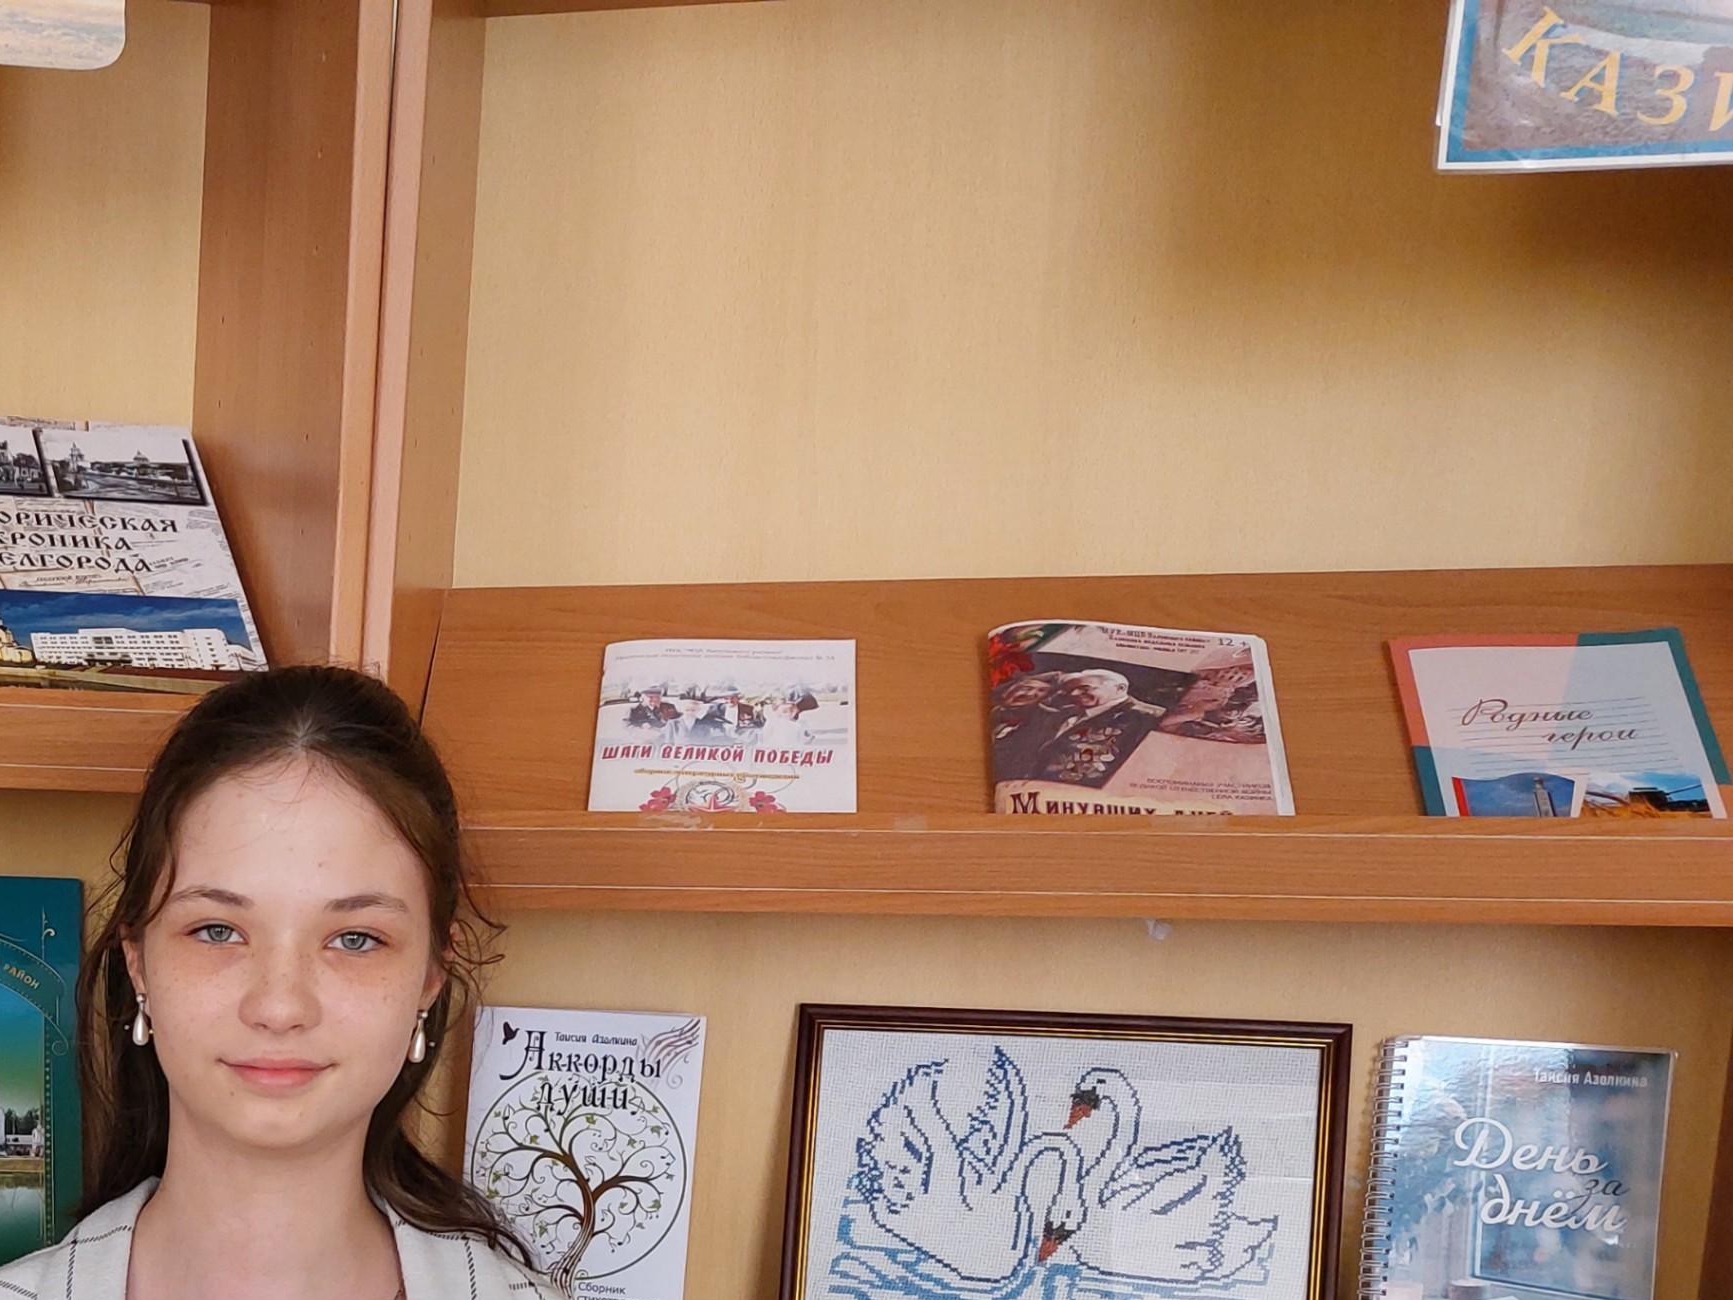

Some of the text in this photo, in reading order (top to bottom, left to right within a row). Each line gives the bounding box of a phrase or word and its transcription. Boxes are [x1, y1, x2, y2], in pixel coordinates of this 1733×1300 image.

[1462, 698, 1594, 731] Родные
[1541, 727, 1638, 750] герои
[602, 744, 834, 765] ШАГИ ВЕЛИКОЙ ПОБЕДЫ
[3, 964, 40, 990] РАЙОН
[499, 1029, 662, 1083] Аккорды
[1584, 1072, 1648, 1088] Азолкина
[537, 1081, 634, 1115] души
[1453, 1116, 1611, 1176] День
[1480, 1174, 1629, 1232] днём
[578, 1281, 626, 1296] Сборник
